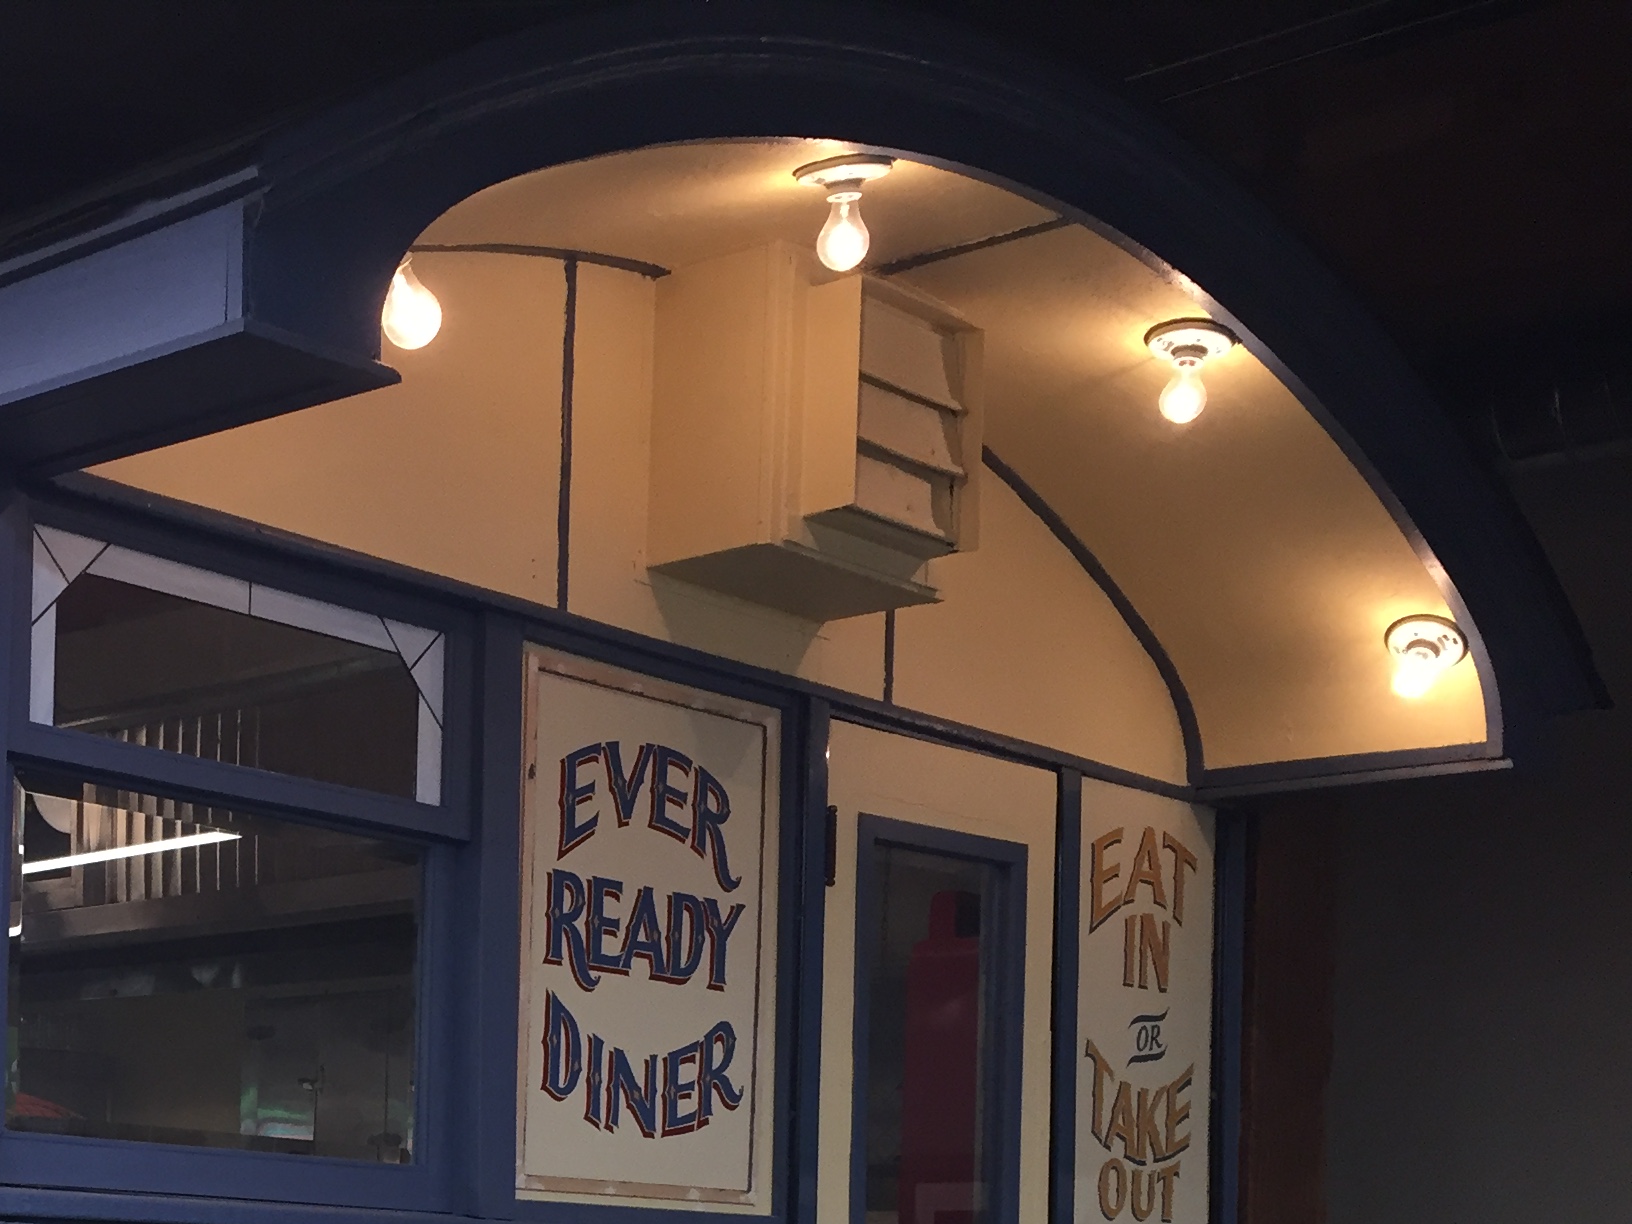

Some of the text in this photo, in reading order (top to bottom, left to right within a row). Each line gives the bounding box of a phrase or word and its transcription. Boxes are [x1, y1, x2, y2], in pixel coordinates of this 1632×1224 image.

[558, 740, 742, 892] EVER
[543, 870, 745, 992] READY
[1088, 826, 1198, 934] EAT
[1123, 913, 1172, 993] IN
[541, 990, 743, 1139] DINER
[1135, 1019, 1164, 1053] OR
[1085, 1039, 1195, 1165] TAKE
[1097, 1157, 1181, 1224] OUT
